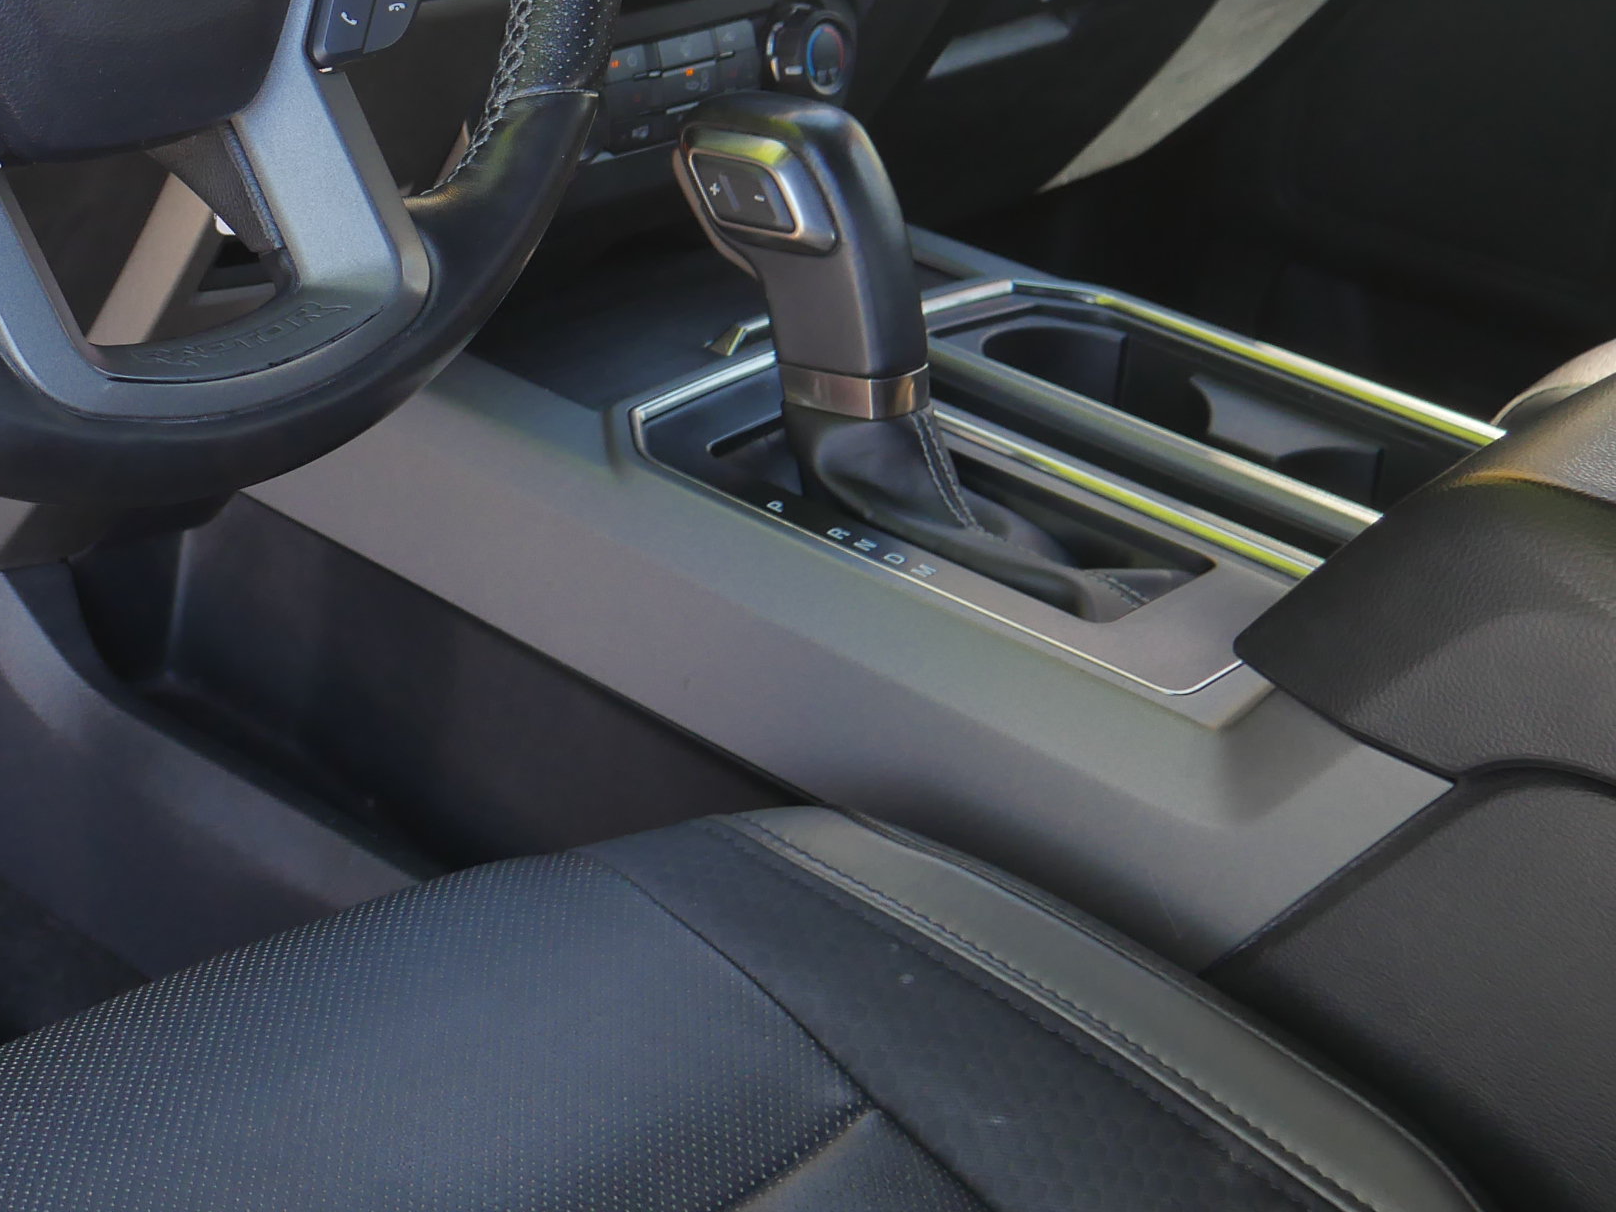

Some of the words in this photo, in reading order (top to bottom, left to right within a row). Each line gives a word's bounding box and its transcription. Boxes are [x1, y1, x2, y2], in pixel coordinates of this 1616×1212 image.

[766, 499, 784, 513] P
[827, 527, 851, 540] R
[853, 538, 878, 552] N
[884, 552, 906, 565] D
[910, 563, 937, 578] M
